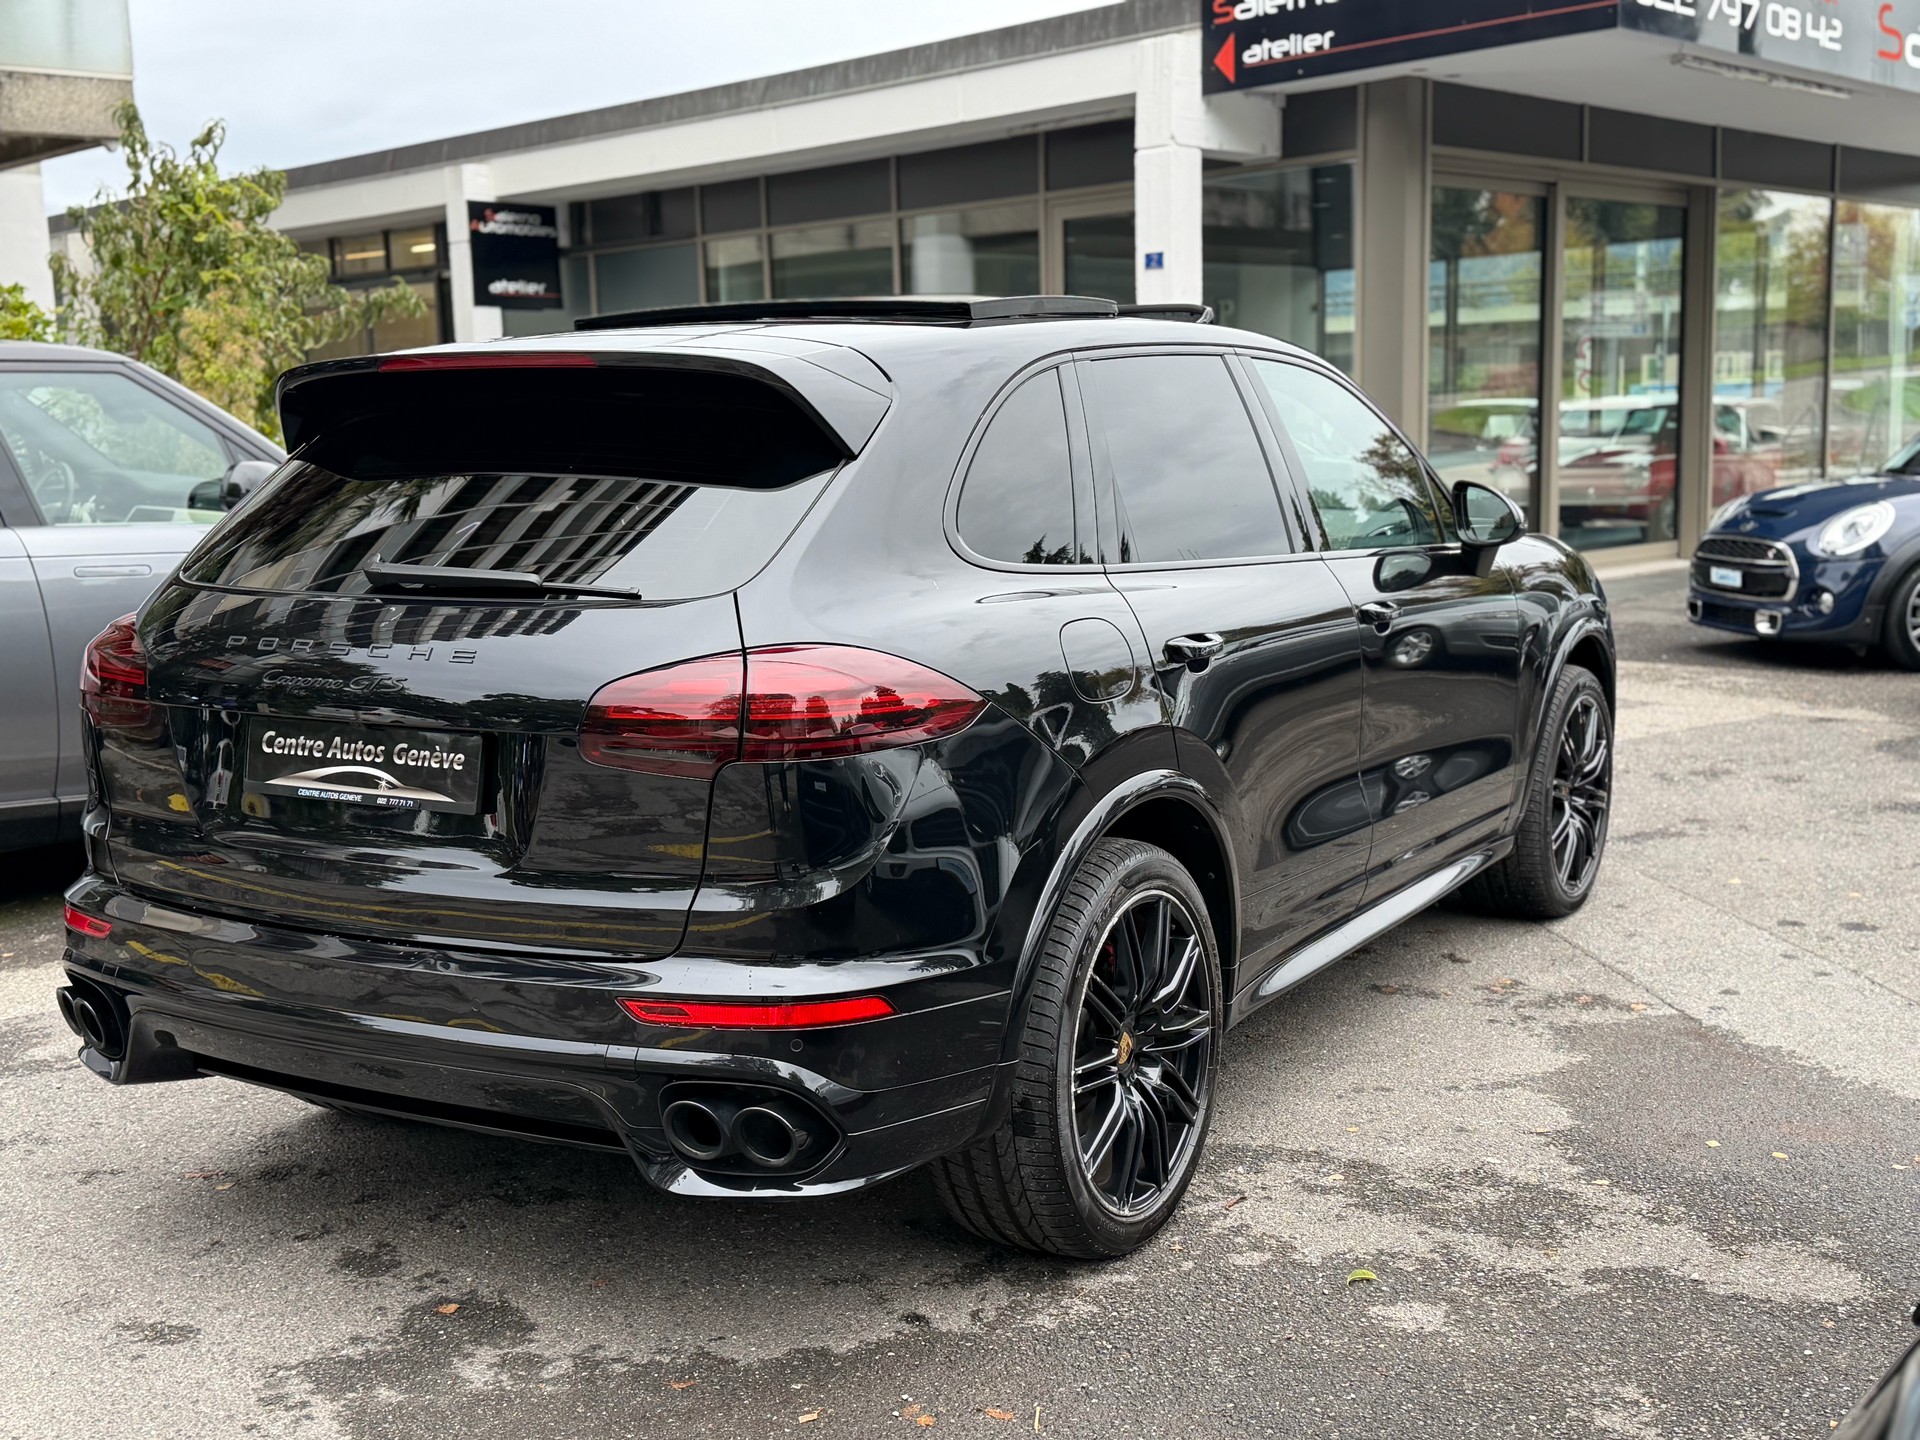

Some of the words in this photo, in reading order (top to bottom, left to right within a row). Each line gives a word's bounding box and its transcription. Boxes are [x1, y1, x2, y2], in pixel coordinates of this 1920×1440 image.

[1766, 2, 1802, 41] 08
[1806, 11, 1842, 51] 42
[1242, 30, 1335, 64] atelier
[488, 278, 547, 295] atelier
[225, 635, 477, 664] PORSCHE
[262, 669, 344, 691] Cayenne
[349, 675, 408, 692] GTS
[261, 730, 325, 758] Centre
[326, 736, 385, 762] Autos
[393, 743, 465, 770] Genève
[298, 788, 320, 798] CENTRE
[320, 791, 339, 800] AUTOS
[339, 793, 362, 802] GENEVE
[399, 799, 406, 807] 71
